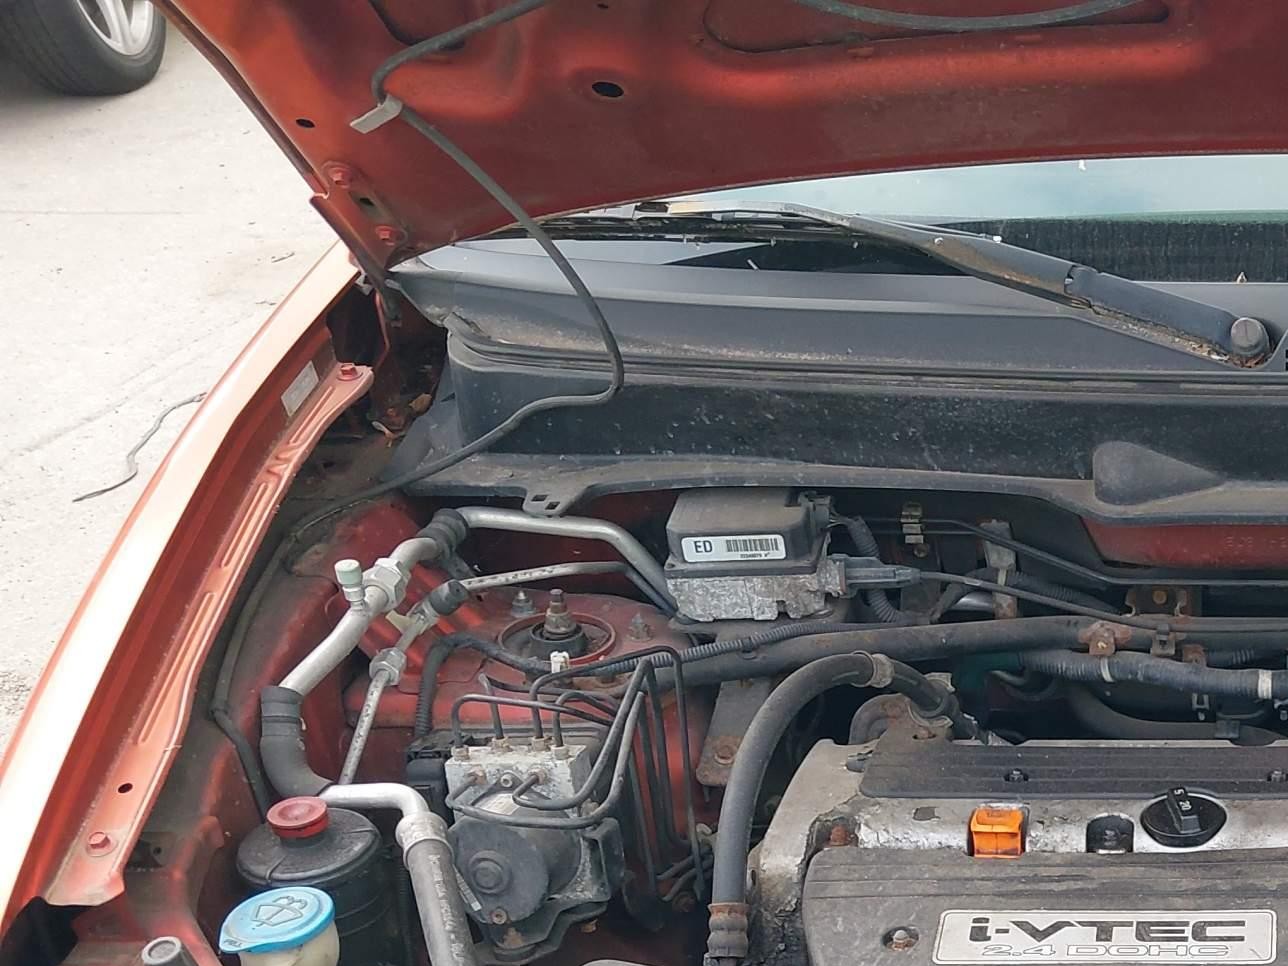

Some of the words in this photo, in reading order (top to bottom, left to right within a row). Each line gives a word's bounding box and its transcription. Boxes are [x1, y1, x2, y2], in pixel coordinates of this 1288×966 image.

[693, 540, 713, 553] ED
[1178, 800, 1192, 811] 20
[968, 917, 1246, 942] i-VTEC
[982, 944, 1056, 956] 2.4
[1066, 944, 1229, 956] DOHC
